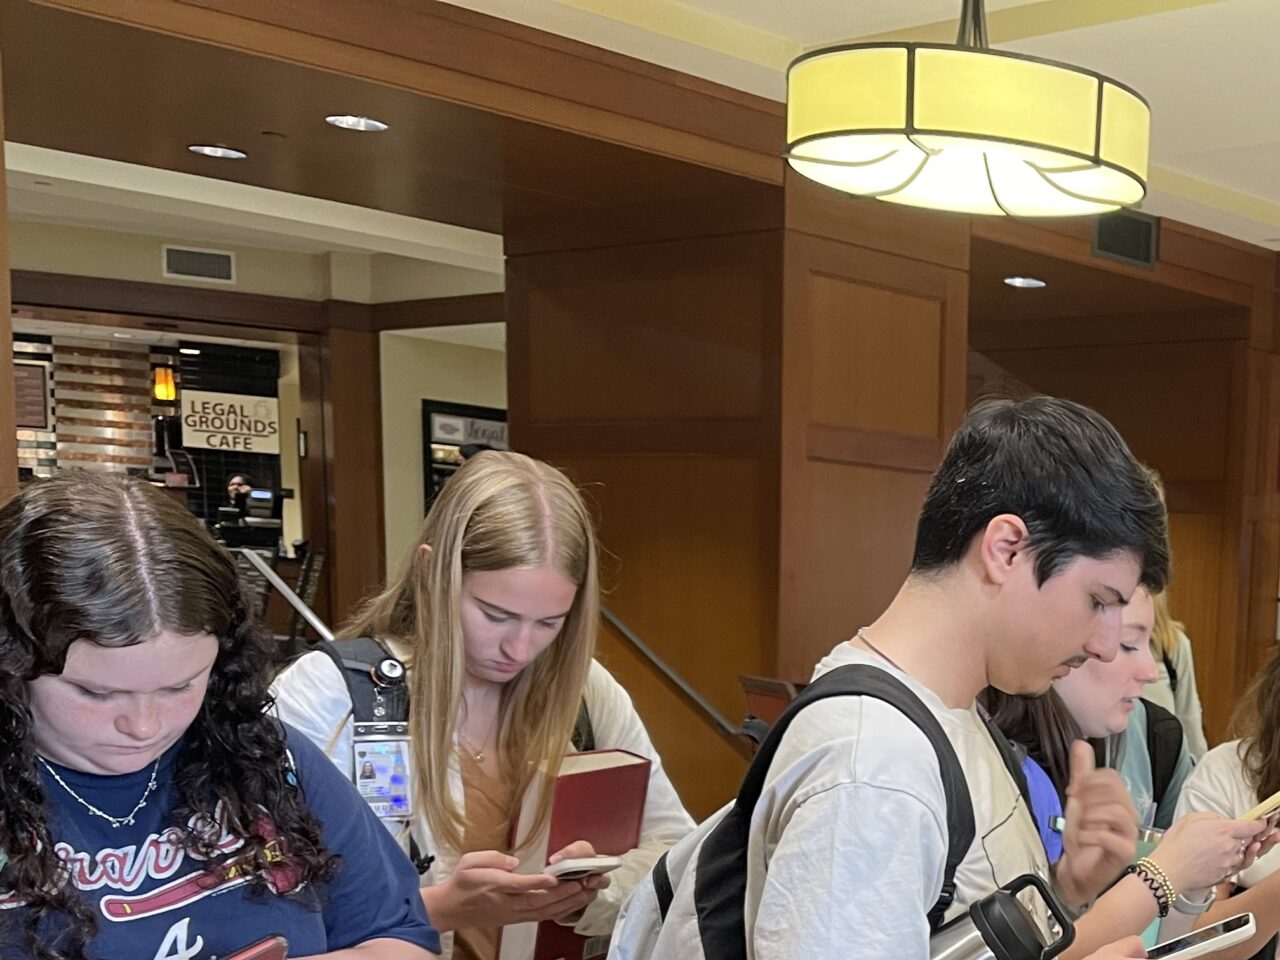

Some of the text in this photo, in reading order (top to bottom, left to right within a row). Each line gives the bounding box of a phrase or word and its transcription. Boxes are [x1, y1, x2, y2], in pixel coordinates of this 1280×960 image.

[191, 400, 249, 418] LEGAL
[184, 414, 278, 434] GROUNDS
[206, 434, 252, 450] CAFE
